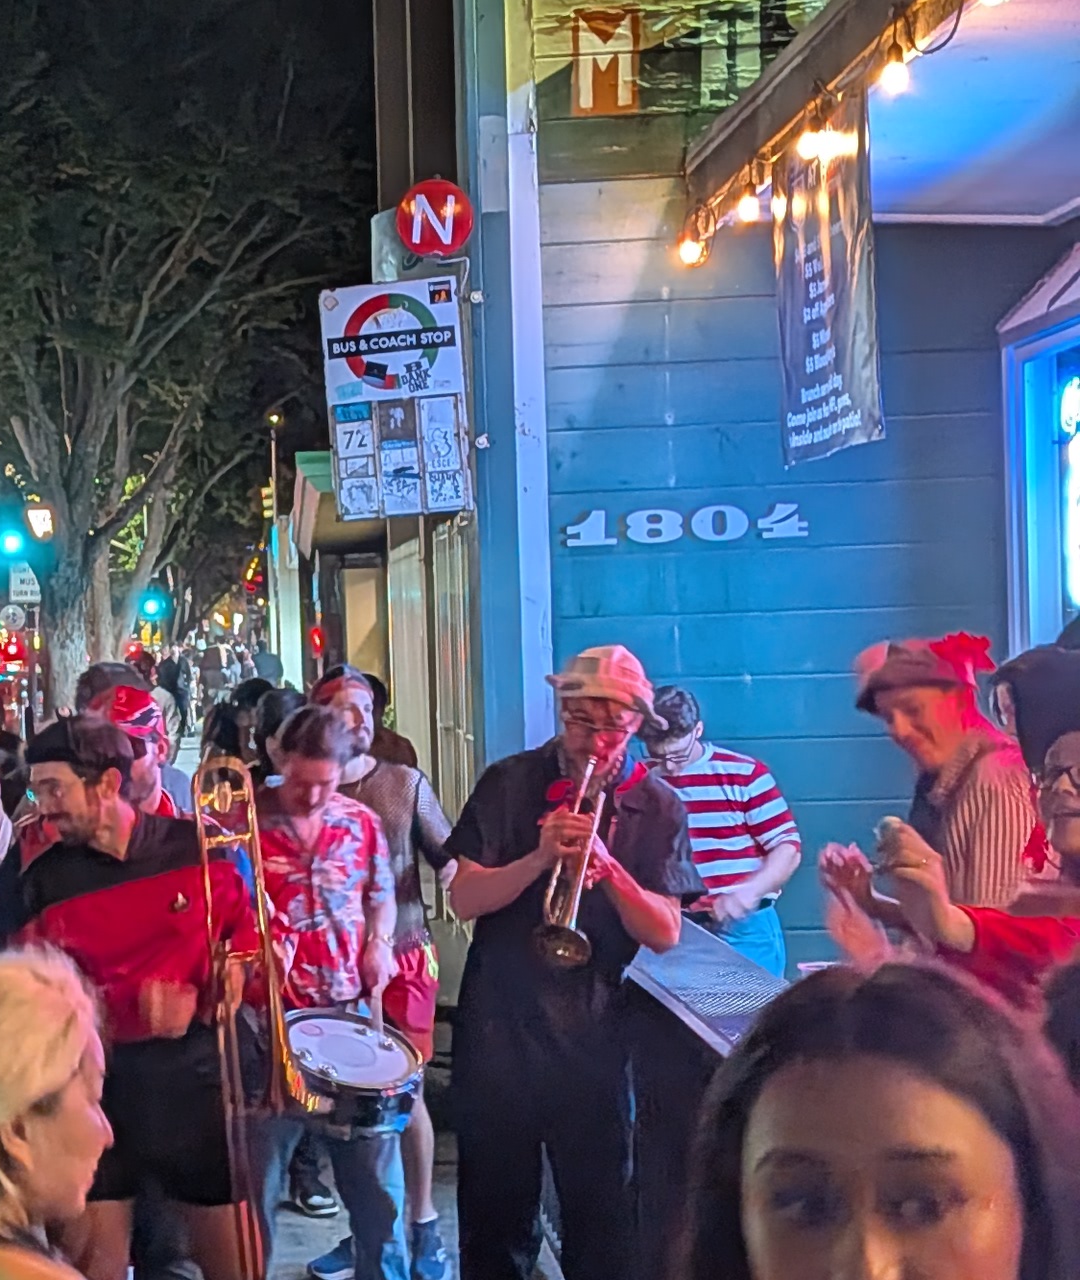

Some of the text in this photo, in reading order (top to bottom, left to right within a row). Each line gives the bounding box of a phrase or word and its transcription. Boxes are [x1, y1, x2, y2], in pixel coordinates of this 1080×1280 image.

[411, 193, 455, 245] N
[332, 330, 451, 354] BUS & COACH STOP
[787, 411, 806, 428] Come
[342, 430, 368, 450] 72
[564, 503, 809, 547] 1804
[19, 577, 36, 586] MUS
